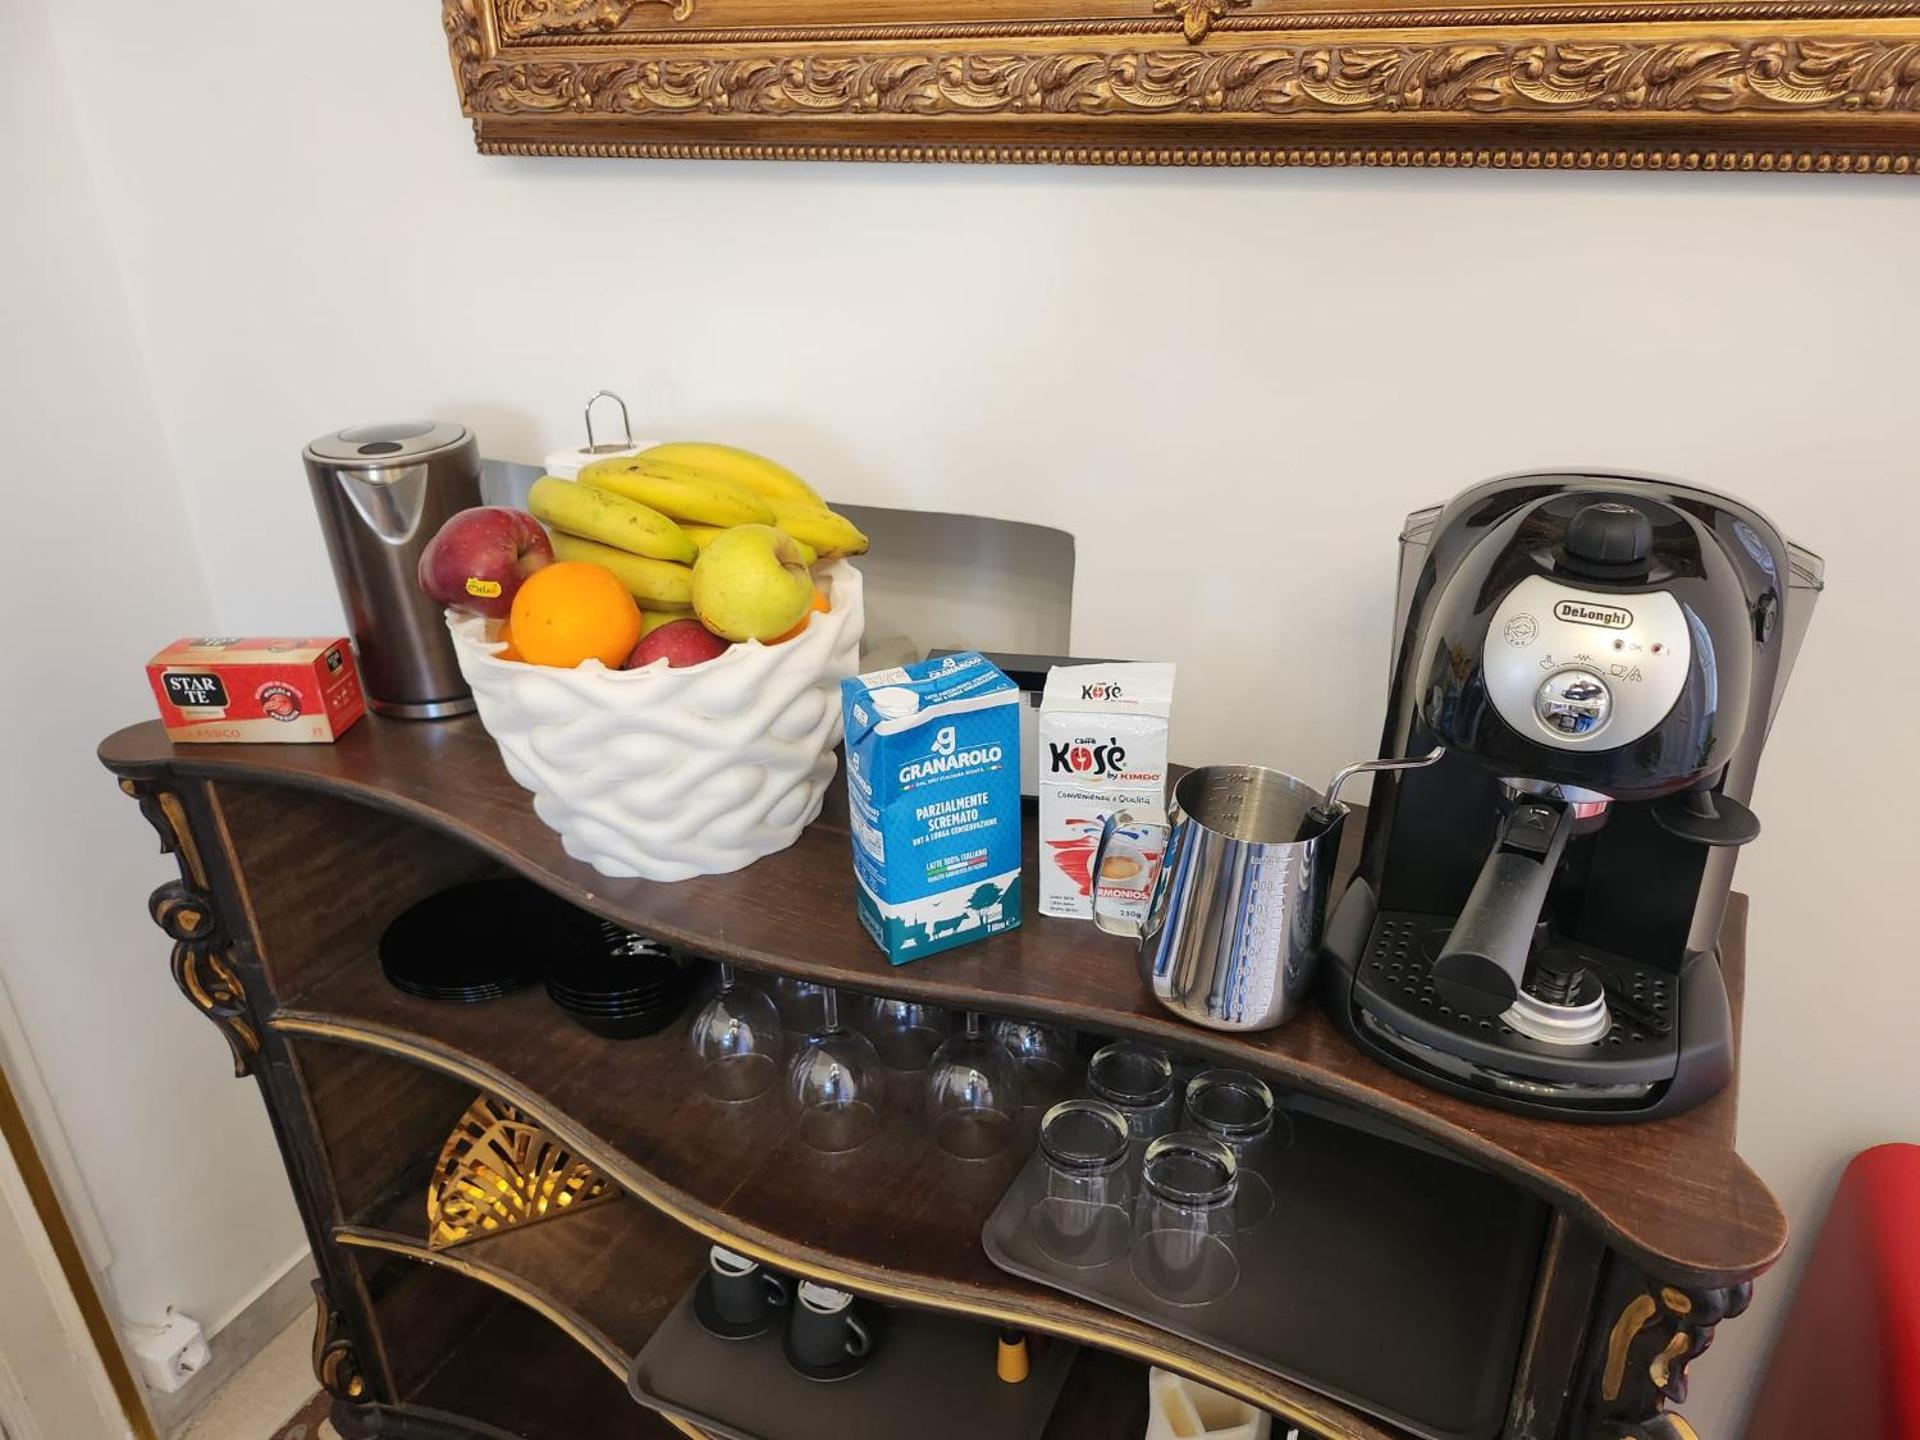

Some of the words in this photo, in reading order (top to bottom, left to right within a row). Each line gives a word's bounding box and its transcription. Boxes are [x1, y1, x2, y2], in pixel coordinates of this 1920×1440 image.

[1561, 605, 1626, 625] DeLonghi
[169, 677, 217, 691] STAR
[184, 690, 210, 704] TE
[899, 746, 1002, 783] GRANAROLO
[1107, 771, 1119, 780] by
[1120, 773, 1161, 781] KIMBO
[916, 792, 989, 821] PARZIALMENTE
[928, 808, 979, 833] SCREMATO
[926, 858, 943, 870] LATTE
